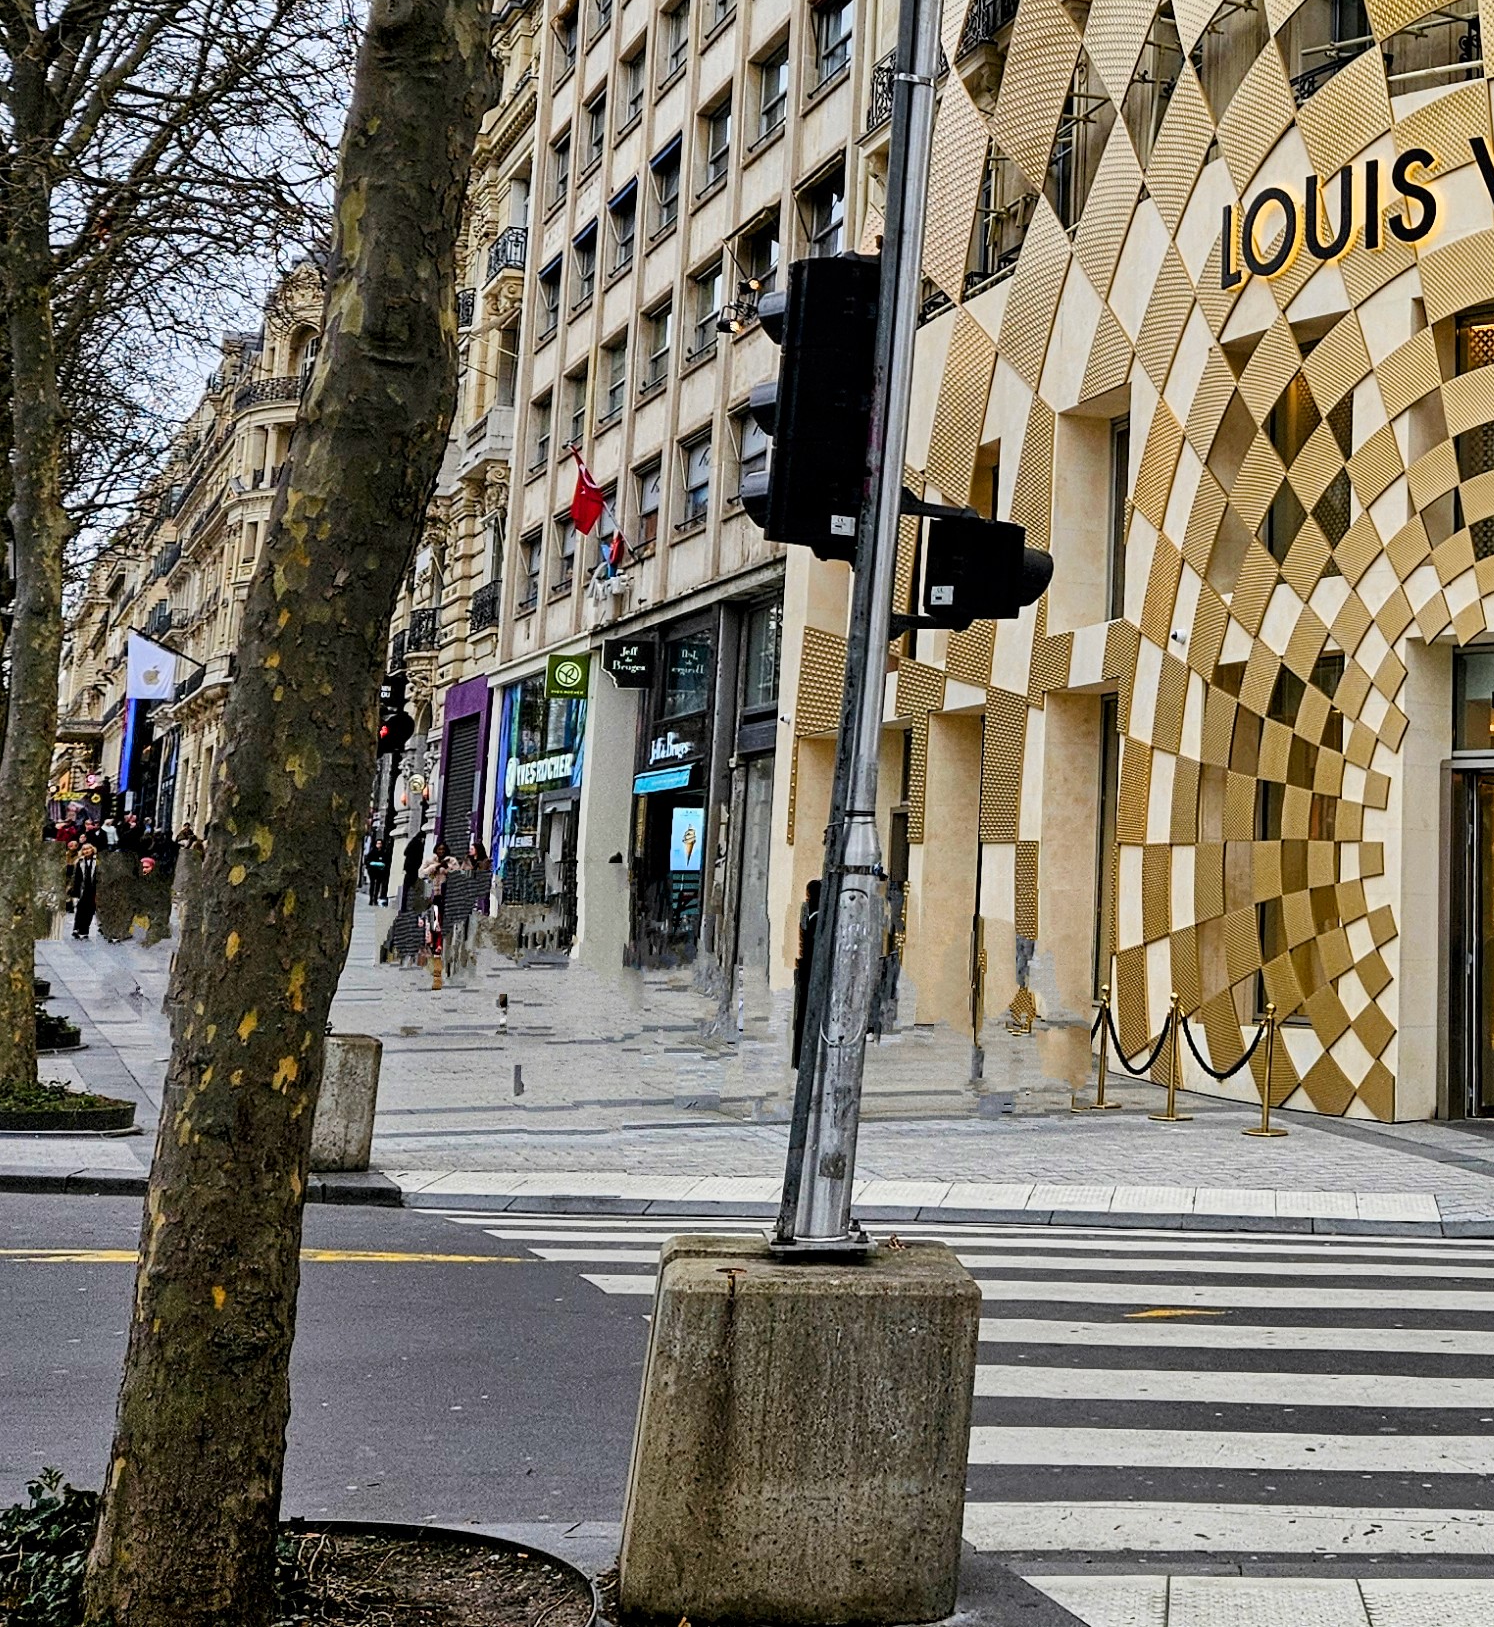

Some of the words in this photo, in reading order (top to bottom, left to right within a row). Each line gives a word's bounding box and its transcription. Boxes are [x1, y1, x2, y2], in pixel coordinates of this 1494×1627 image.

[1221, 148, 1438, 290] LOUIS
[620, 646, 638, 657] Jeff
[612, 660, 646, 673] Bruges
